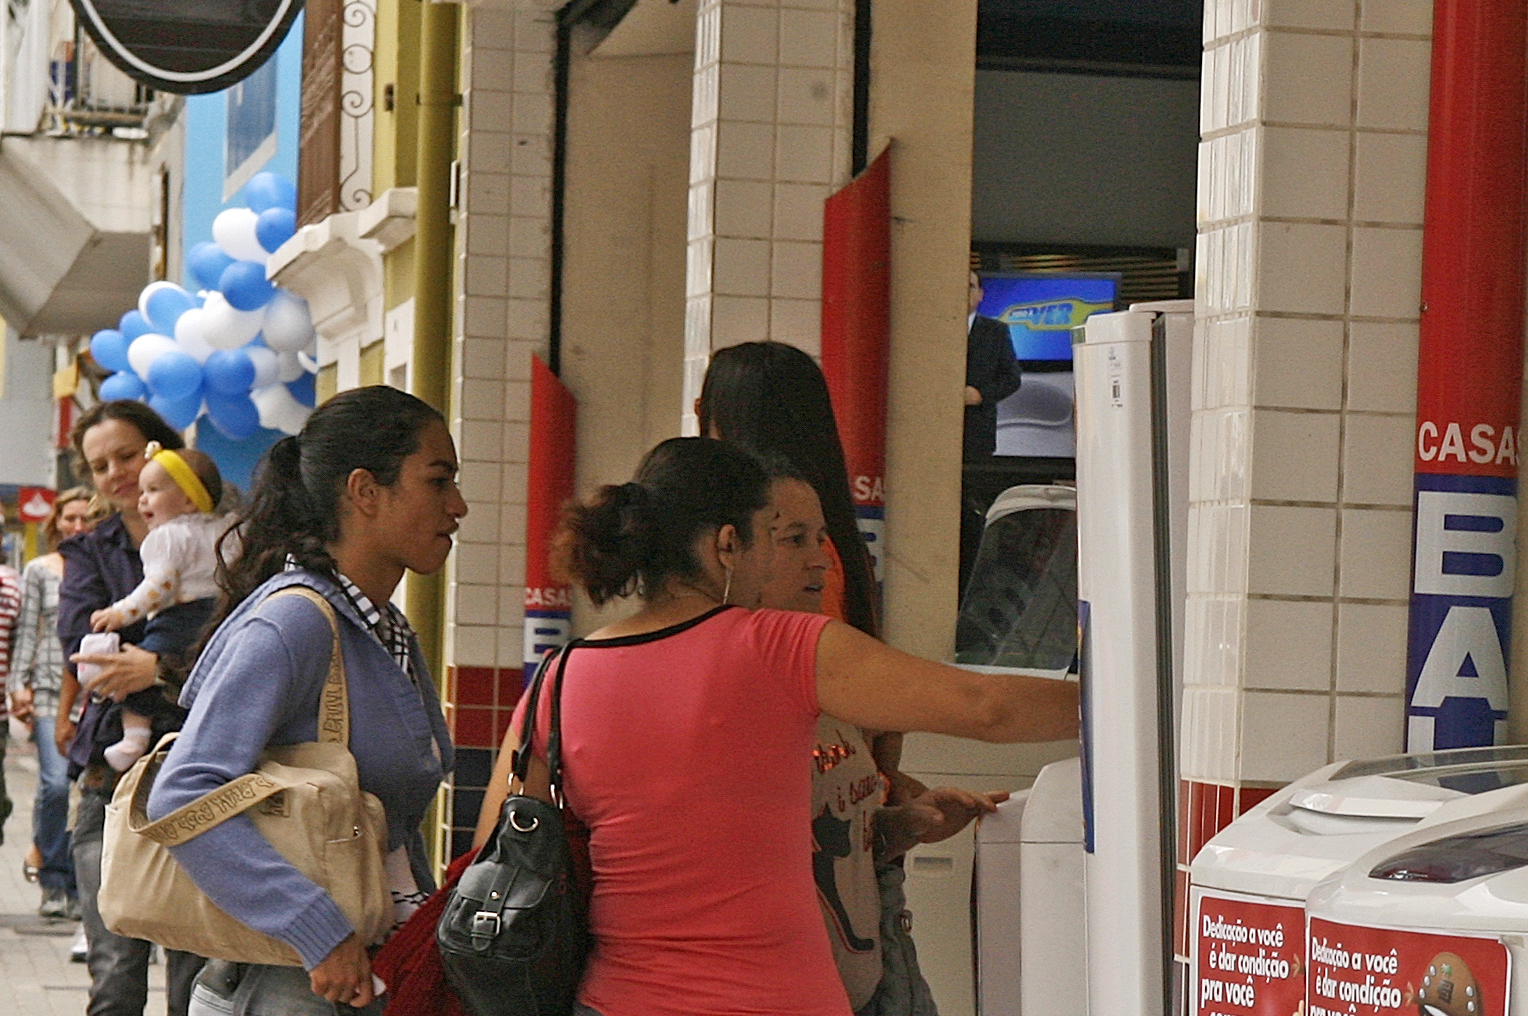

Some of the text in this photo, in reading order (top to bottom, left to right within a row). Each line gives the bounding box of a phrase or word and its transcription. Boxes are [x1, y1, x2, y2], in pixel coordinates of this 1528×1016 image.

[1203, 915, 1283, 947] Dedicação a você
[1209, 942, 1289, 983] é dar condição
[1312, 937, 1397, 974] Dedicação a você
[1201, 975, 1254, 1008] pra você
[1316, 967, 1401, 1013] é dar condição
